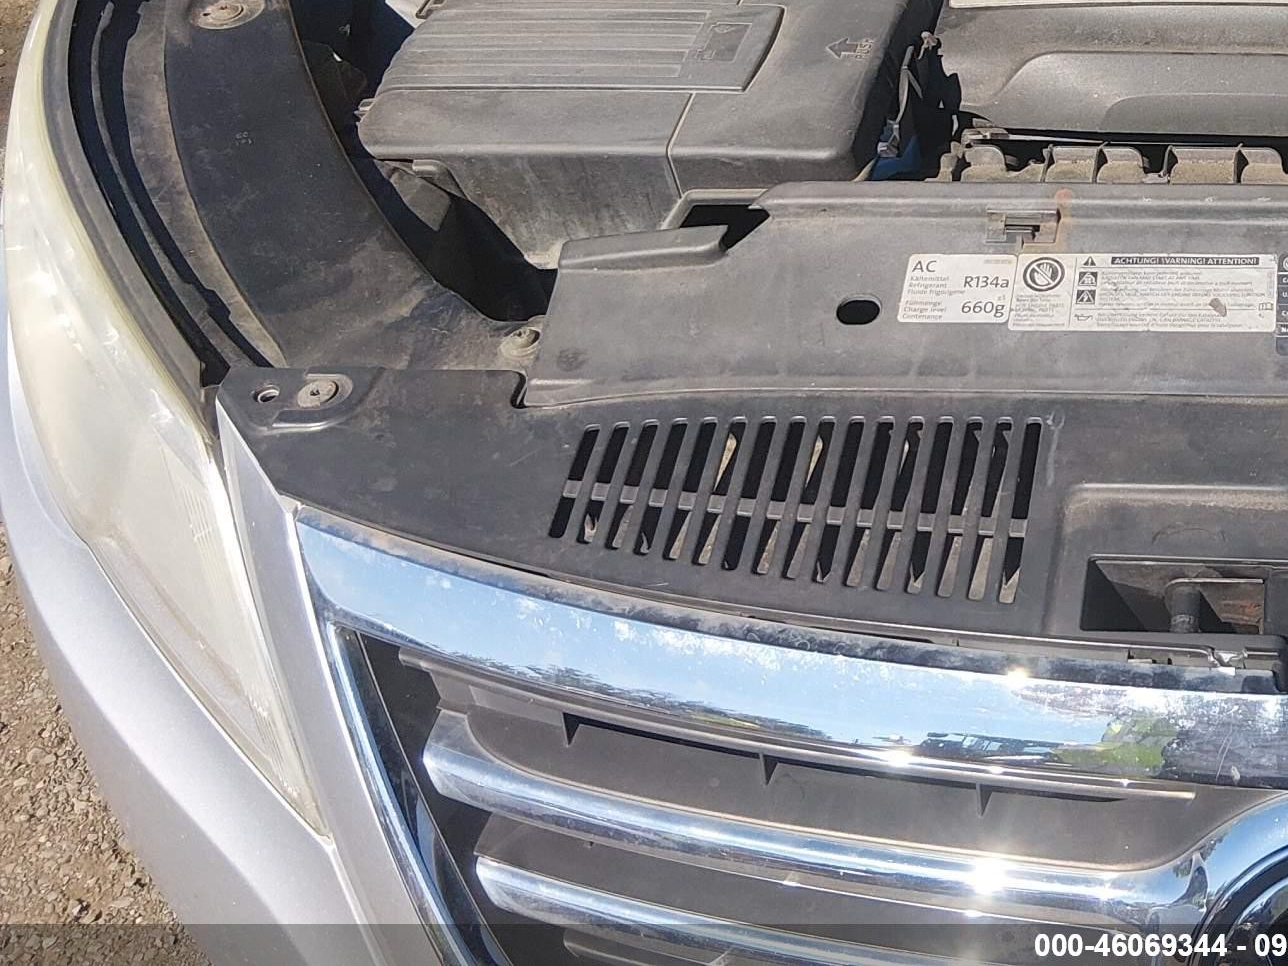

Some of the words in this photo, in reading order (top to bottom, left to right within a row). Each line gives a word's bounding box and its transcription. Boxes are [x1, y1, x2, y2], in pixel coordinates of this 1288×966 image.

[911, 260, 937, 273] AC
[963, 275, 1010, 289] R134a
[961, 300, 1006, 319] 660g
